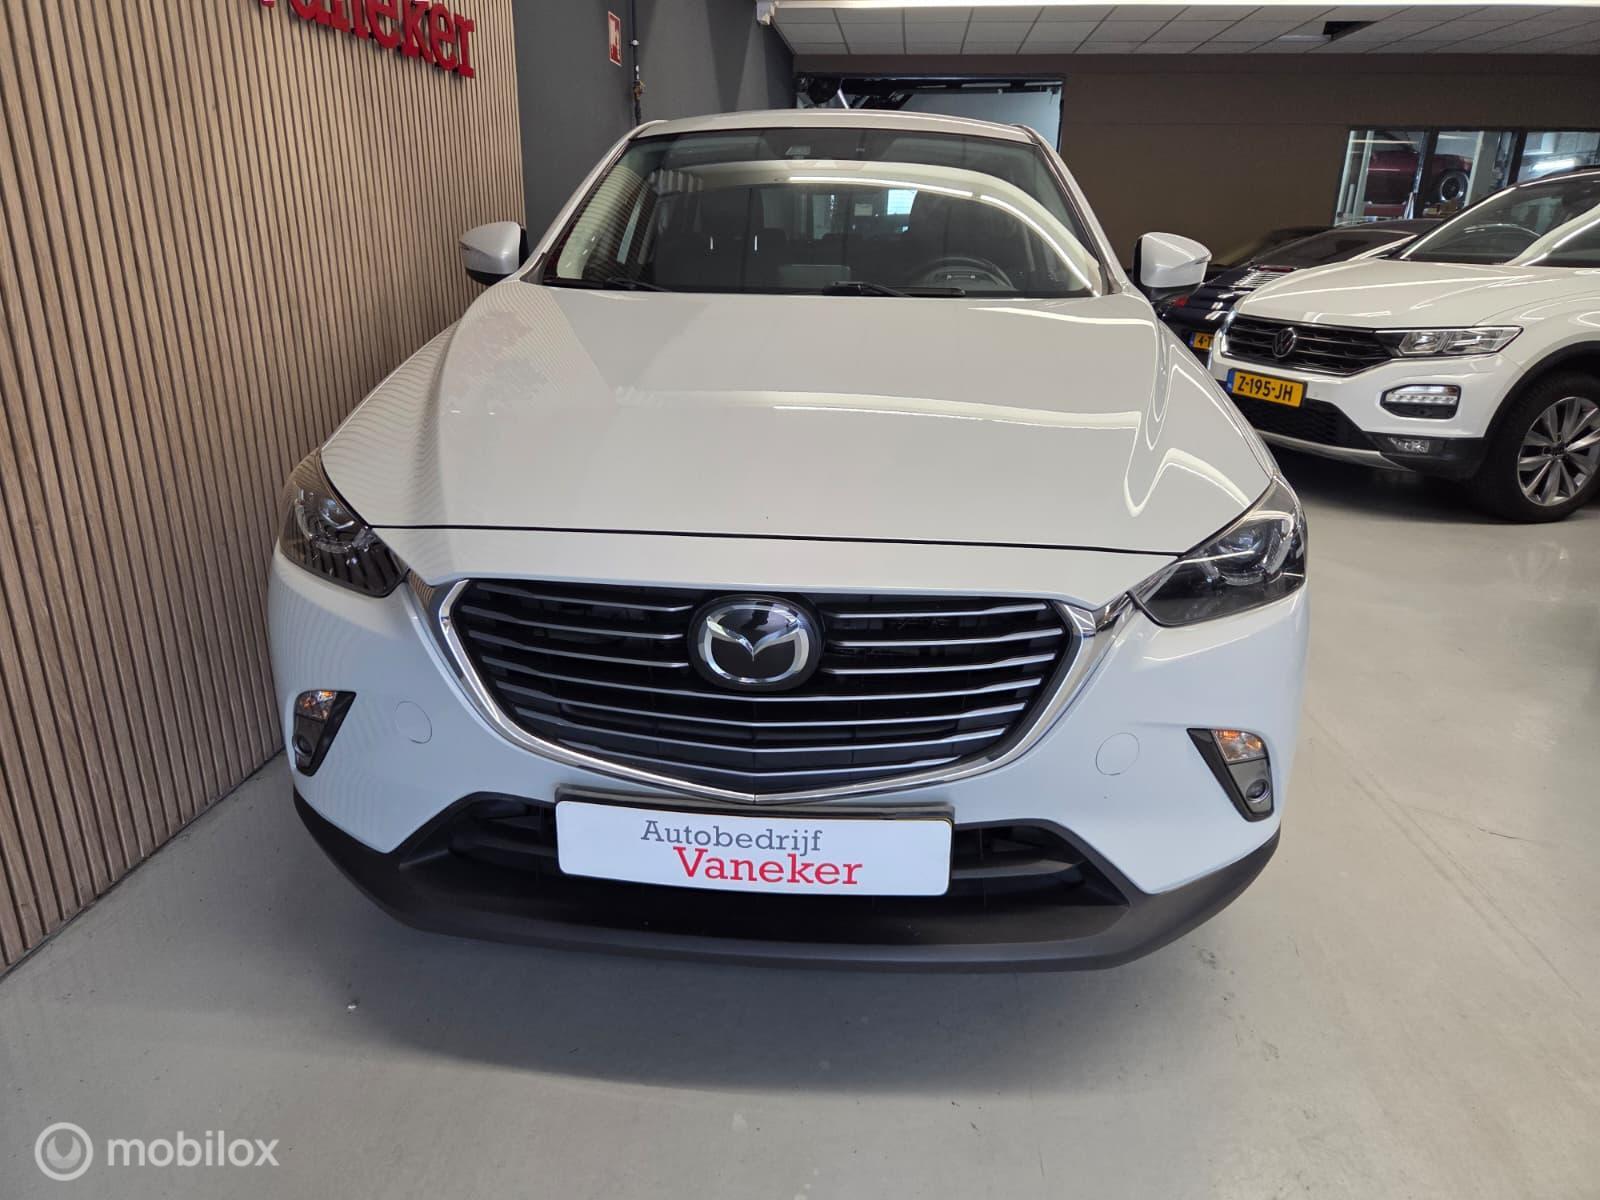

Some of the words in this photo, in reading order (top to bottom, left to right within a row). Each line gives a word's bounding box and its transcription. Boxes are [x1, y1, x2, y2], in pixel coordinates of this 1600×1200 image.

[260, 0, 475, 79] eker
[1238, 376, 1293, 401] Z-195-JH
[640, 819, 823, 857] Autobedrijf
[673, 845, 863, 885] Vaneker
